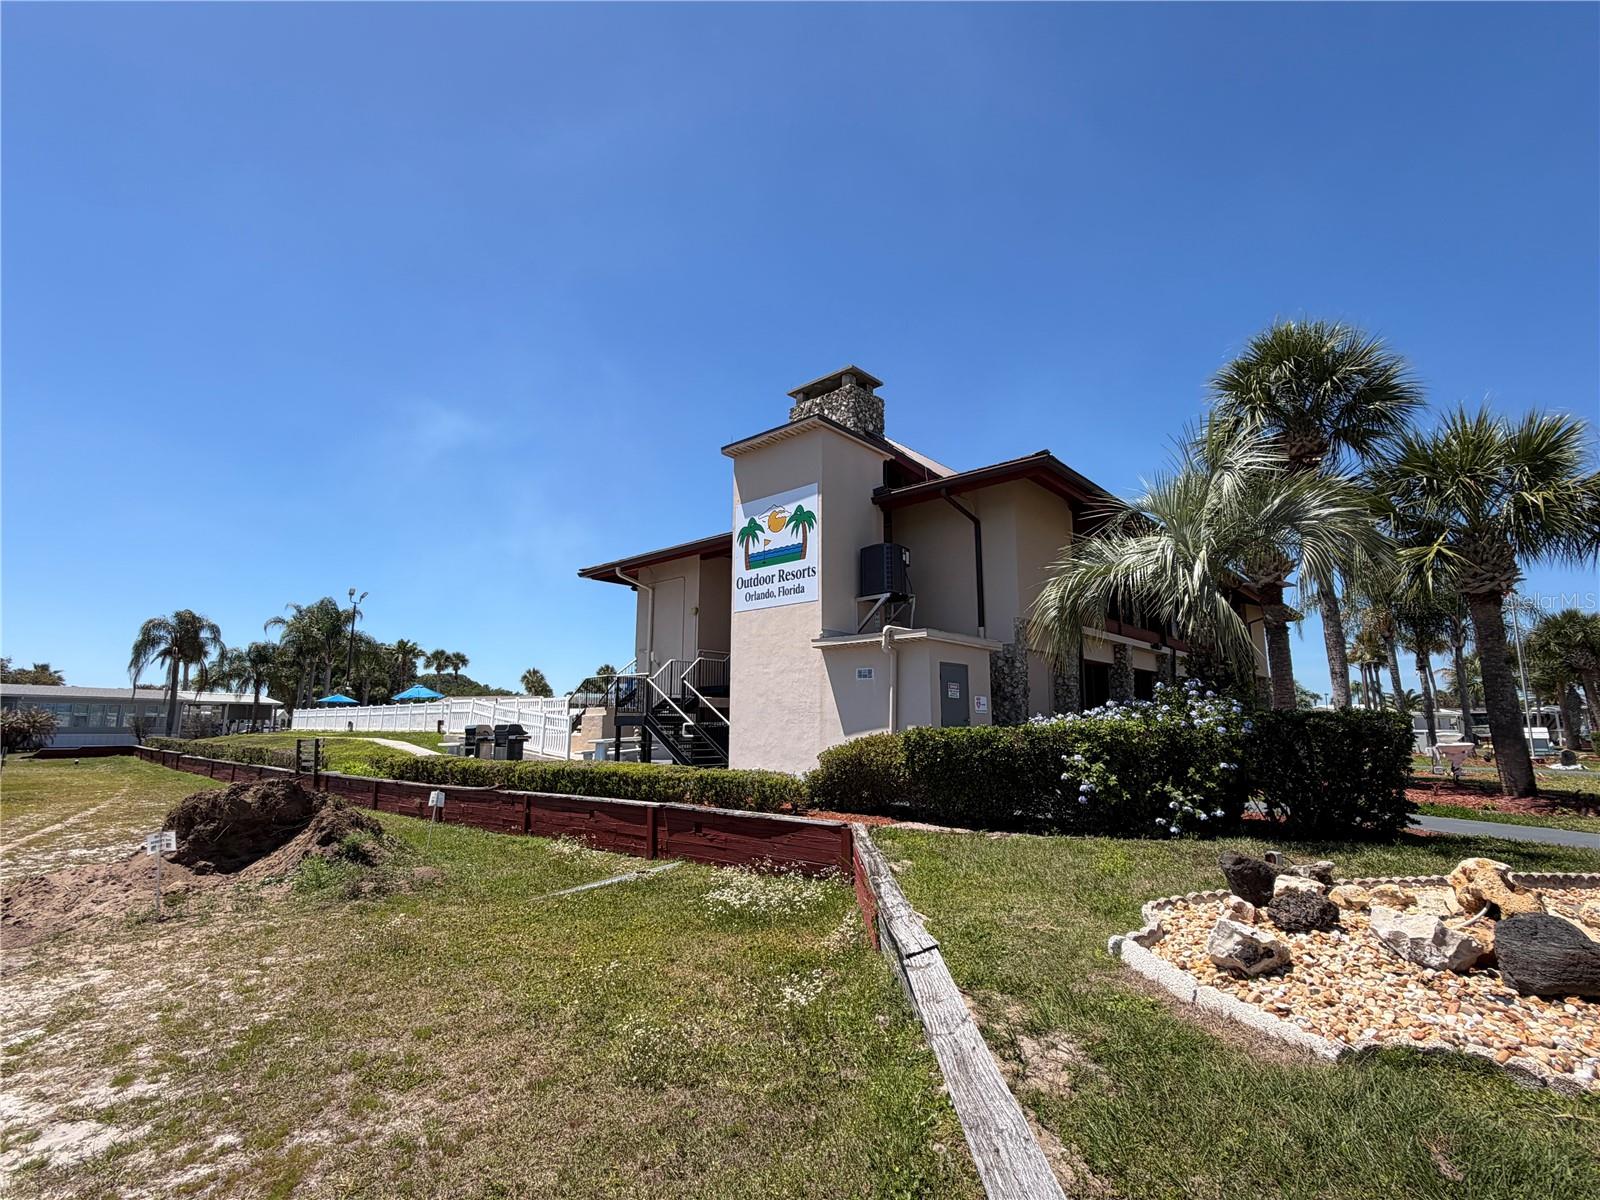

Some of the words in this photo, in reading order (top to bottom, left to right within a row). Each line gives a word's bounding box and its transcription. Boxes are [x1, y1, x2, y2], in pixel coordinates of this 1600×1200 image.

[736, 573, 775, 590] Outdoor
[778, 566, 816, 583] Resorts
[745, 588, 776, 602] Orlando,
[778, 583, 805, 597] Florida
